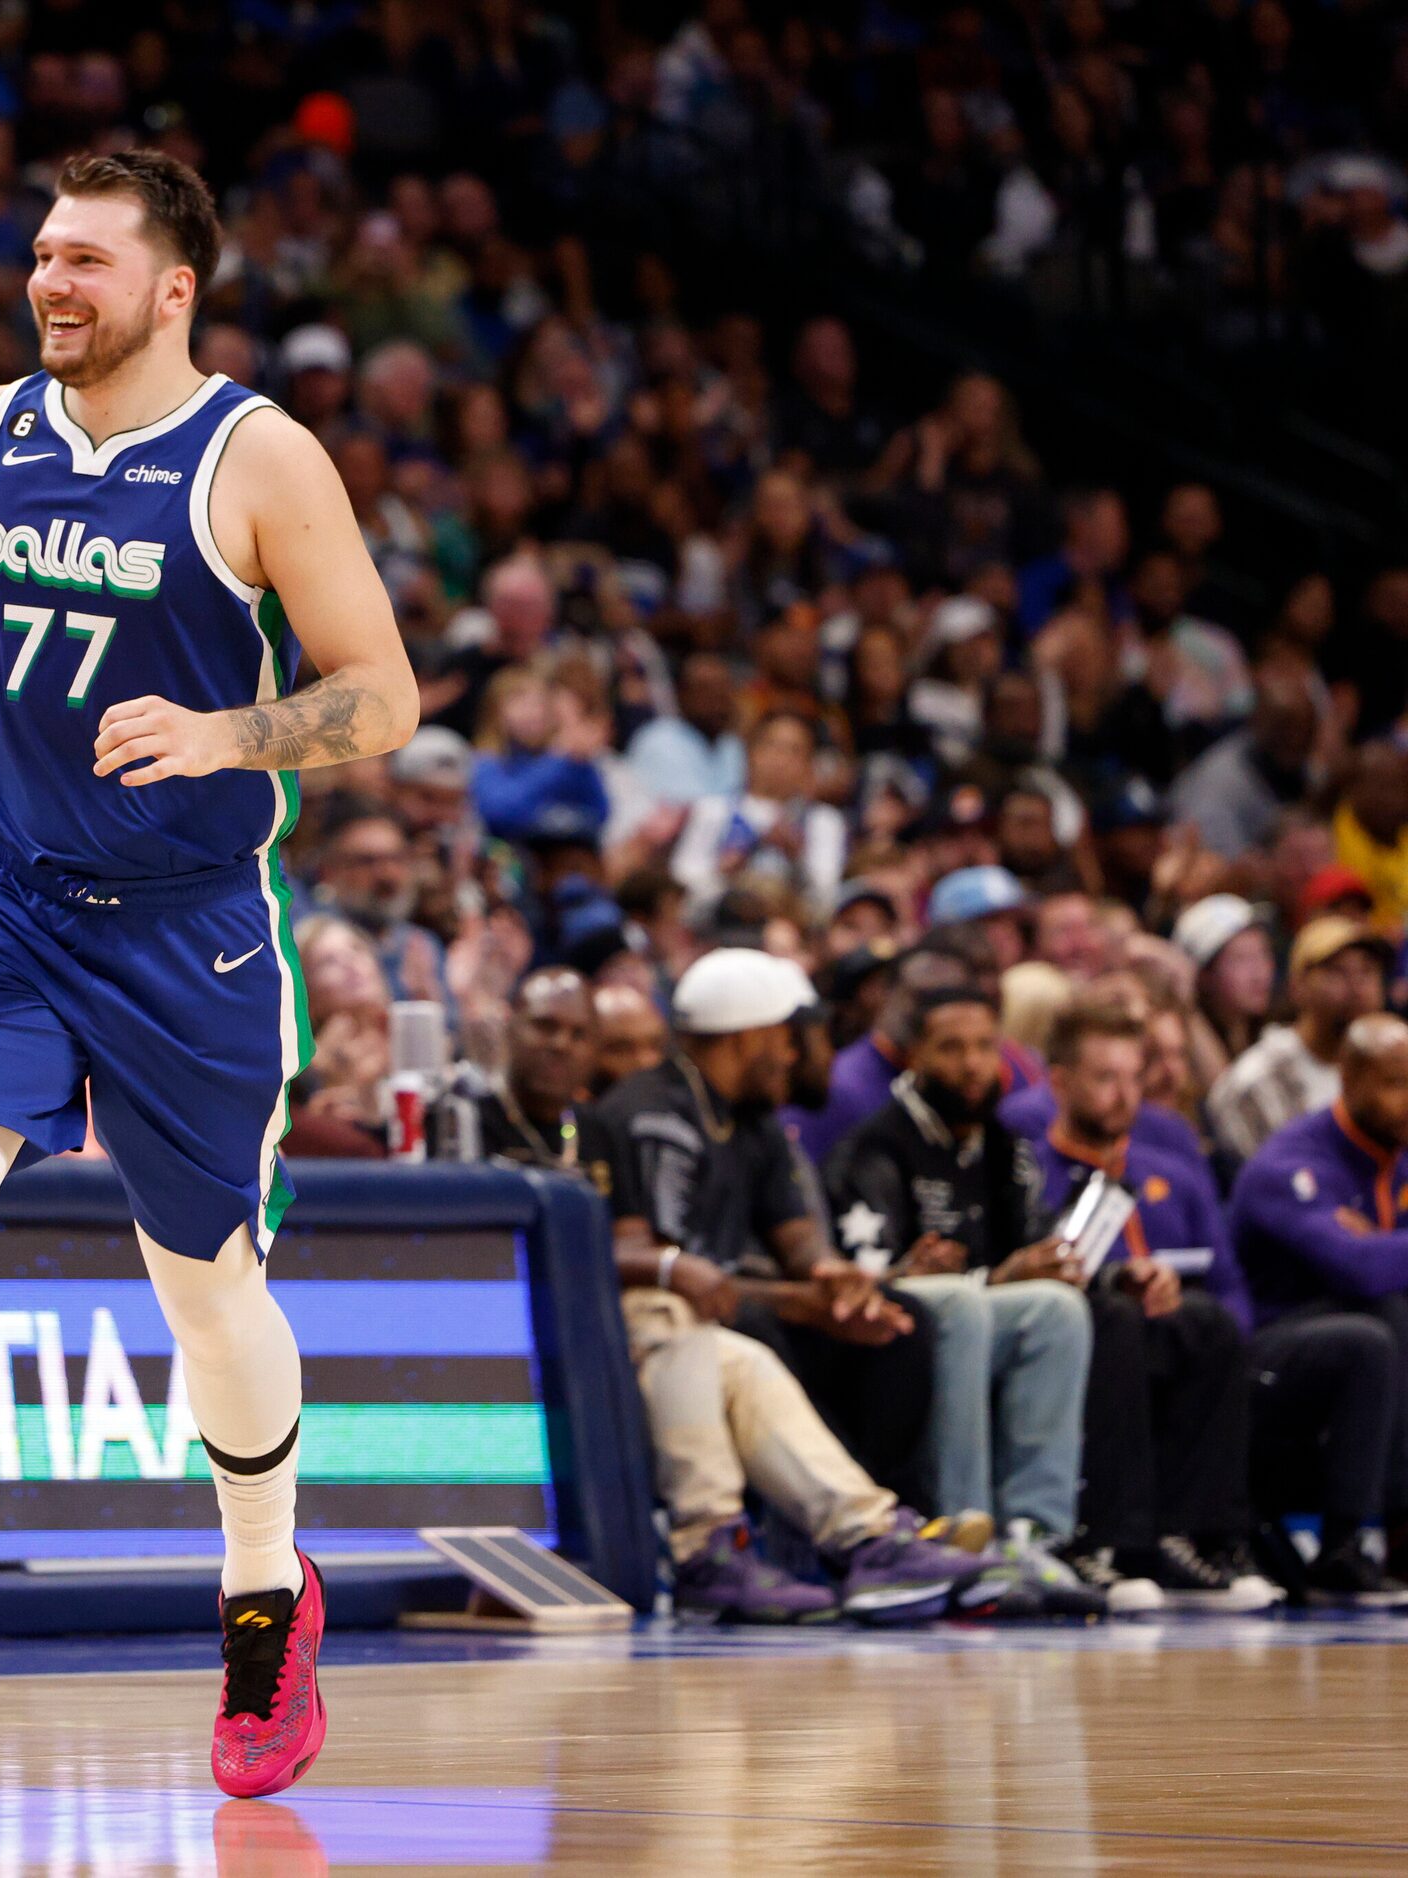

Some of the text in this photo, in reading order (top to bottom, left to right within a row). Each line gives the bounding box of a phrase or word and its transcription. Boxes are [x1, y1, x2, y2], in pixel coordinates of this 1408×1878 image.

[12, 412, 35, 438] 6
[124, 464, 183, 485] chime
[3, 603, 118, 709] 77
